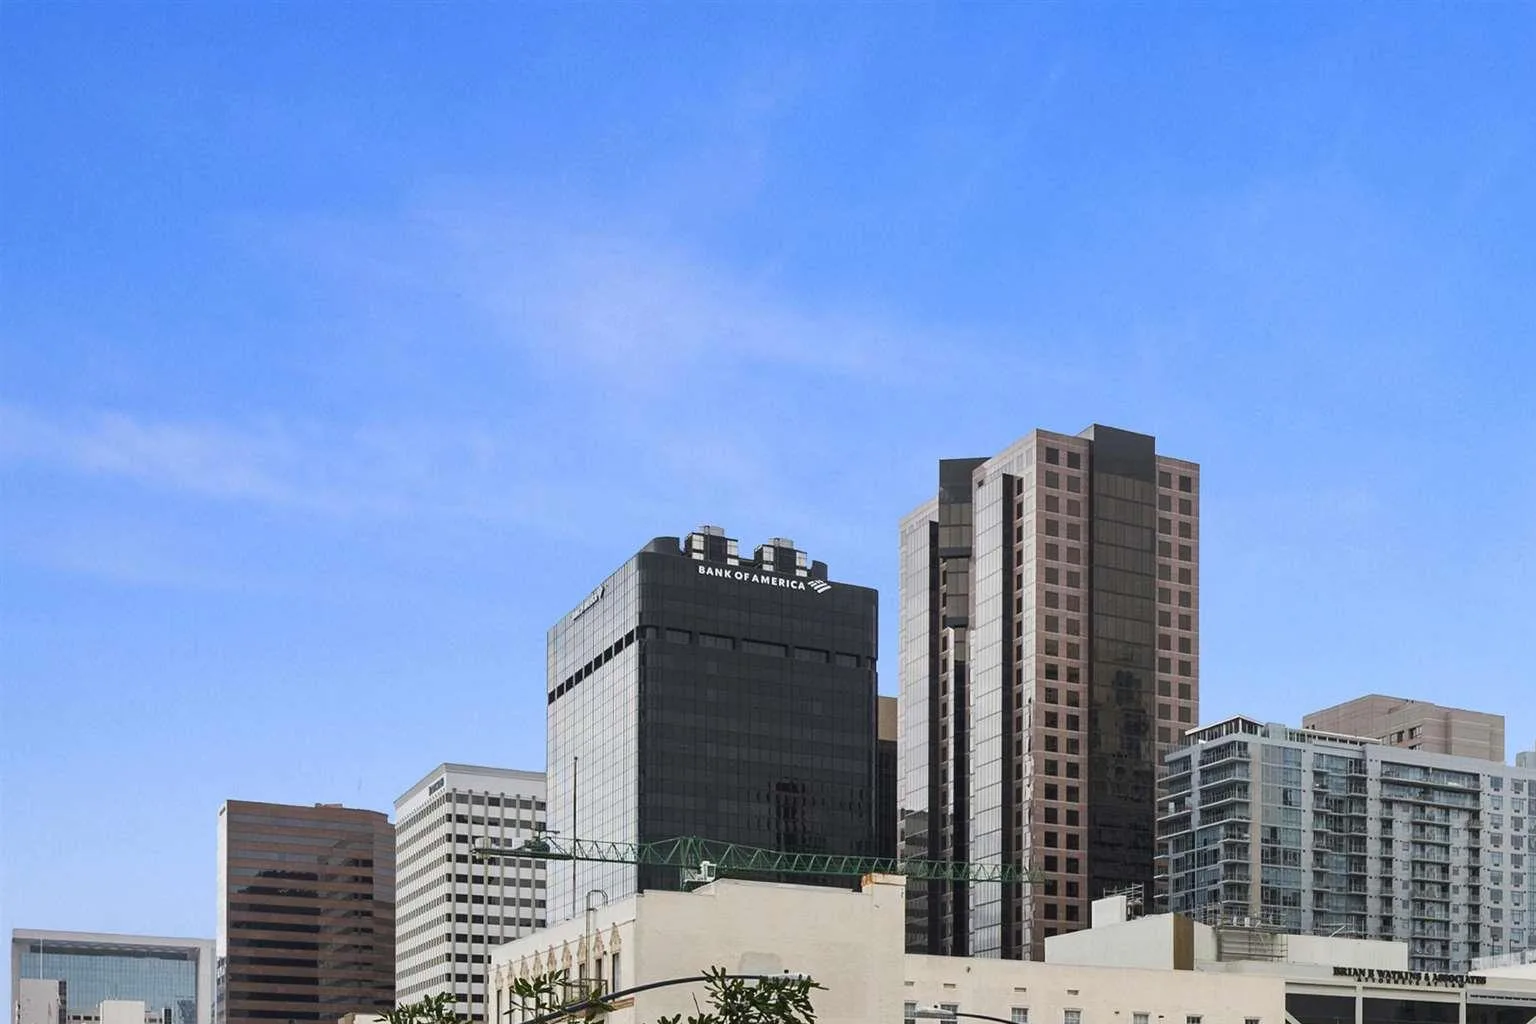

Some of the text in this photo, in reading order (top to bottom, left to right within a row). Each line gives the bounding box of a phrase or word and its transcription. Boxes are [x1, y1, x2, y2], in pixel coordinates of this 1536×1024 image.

[698, 565, 806, 591] BANK OF AMERICA
[1333, 966, 1366, 977] BRIAN
[1376, 969, 1422, 981] WATKINS
[1424, 973, 1430, 981] &
[1432, 973, 1487, 985] ASSOCIATES
